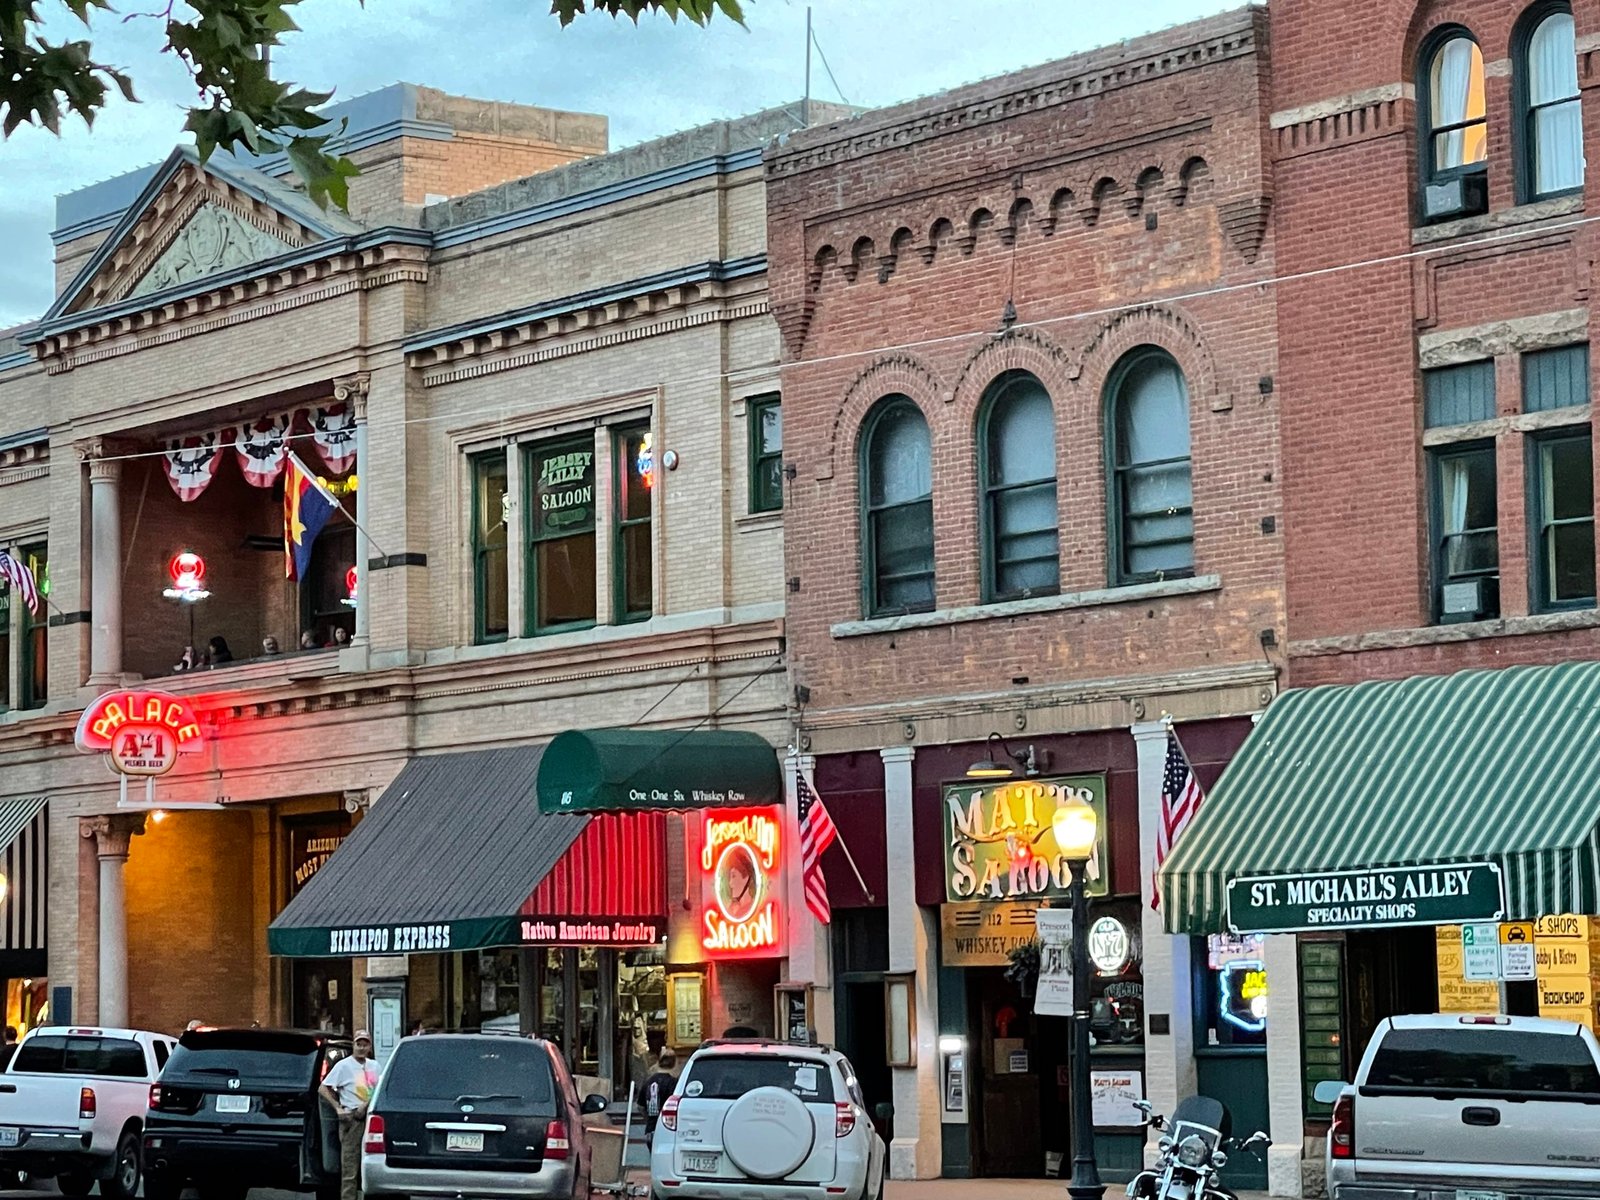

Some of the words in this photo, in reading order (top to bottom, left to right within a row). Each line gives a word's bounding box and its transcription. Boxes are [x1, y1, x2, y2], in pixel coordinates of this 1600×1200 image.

[541, 452, 592, 479] JERSEY
[548, 466, 586, 486] LILLY
[542, 485, 592, 510] SALOON
[93, 696, 200, 743] PALACE
[673, 790, 685, 801] Six
[692, 790, 725, 803] Whiskey
[728, 790, 745, 801] Row
[295, 856, 318, 885] MOST
[1250, 883, 1281, 906] ST.
[1287, 873, 1397, 905] MICHAEL'S
[1401, 869, 1473, 899] ALLEY
[987, 913, 1002, 926] 112
[1307, 906, 1373, 923] SPECIALTY
[1375, 903, 1416, 920] SHOPS
[521, 921, 556, 940] Native
[559, 921, 610, 940] American
[612, 922, 656, 944] Jewelry
[703, 903, 774, 949] SALOON
[1547, 917, 1578, 934] SHOPS
[393, 925, 450, 951] EXPRESS
[955, 936, 1007, 955] WHISKEY
[1464, 928, 1473, 944] 2
[1559, 948, 1577, 965] Bistro
[1543, 991, 1585, 1005] BOOKSHOP
